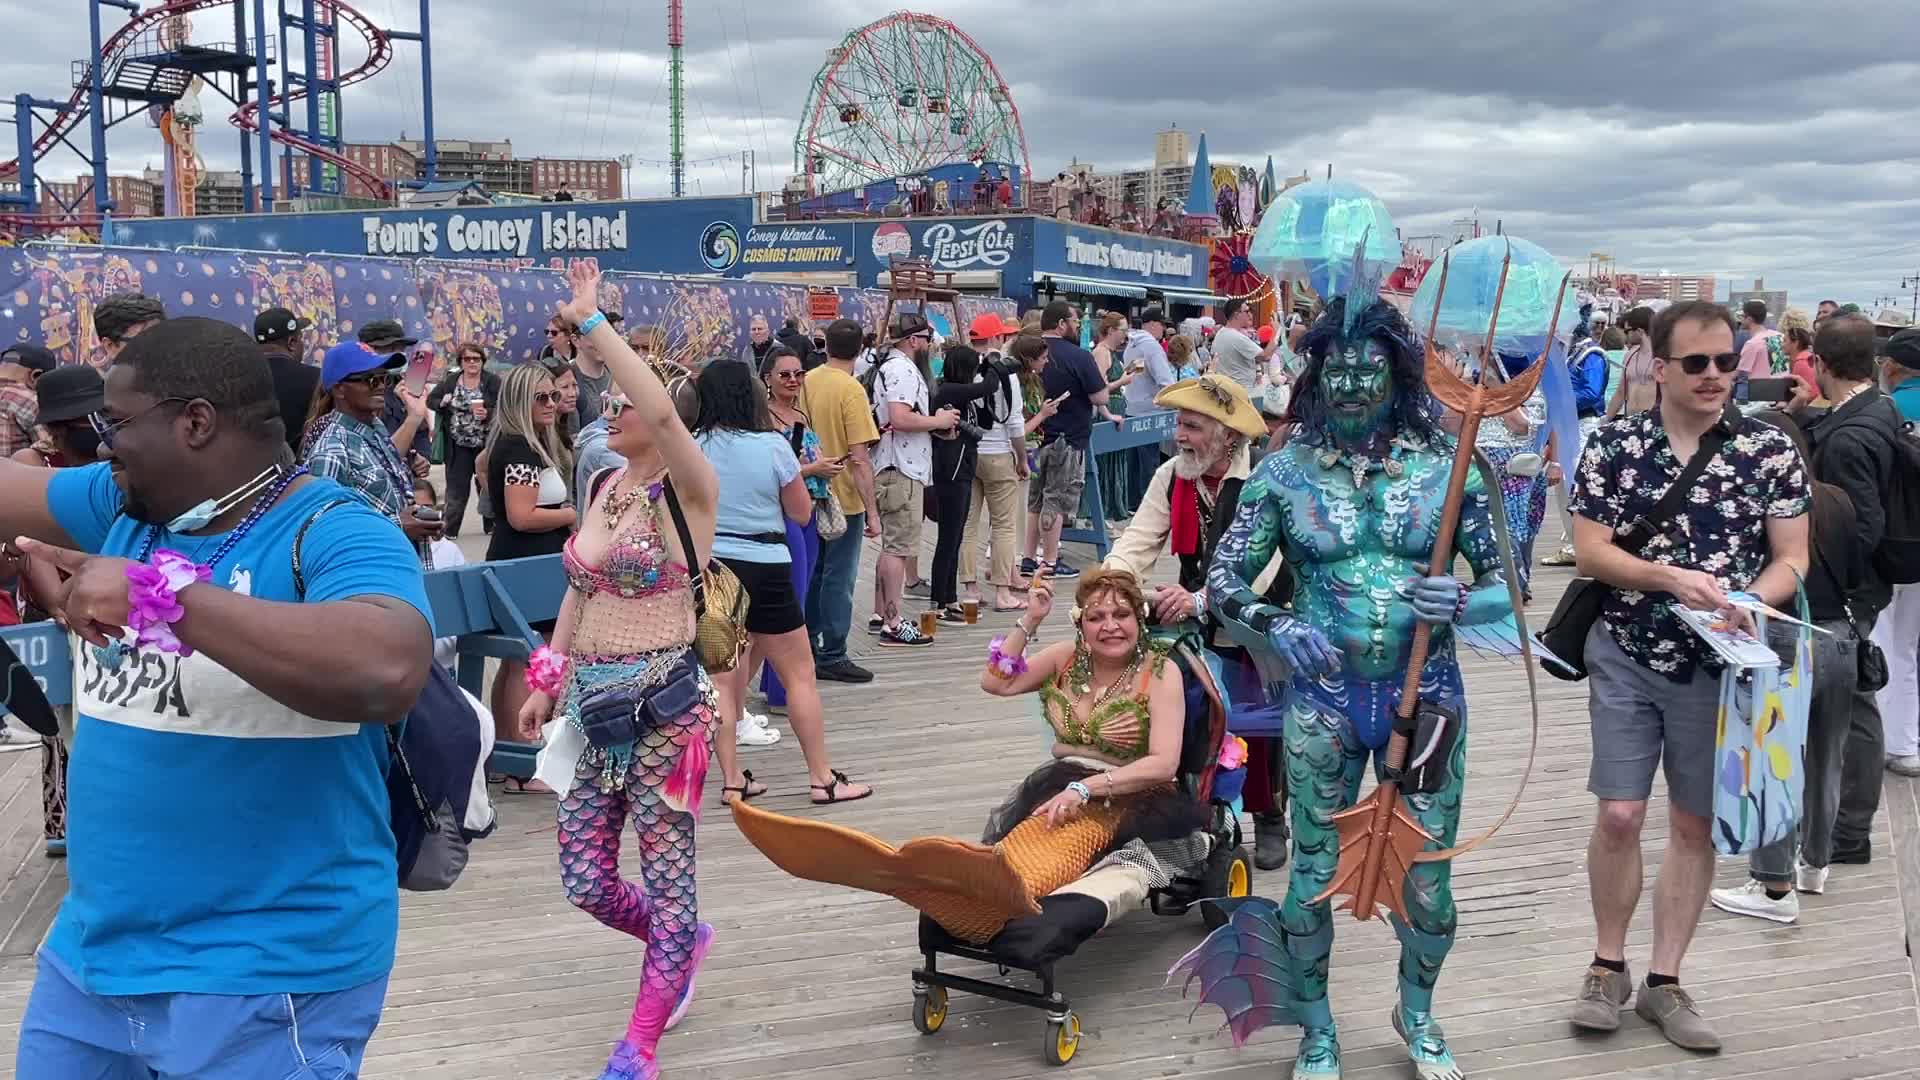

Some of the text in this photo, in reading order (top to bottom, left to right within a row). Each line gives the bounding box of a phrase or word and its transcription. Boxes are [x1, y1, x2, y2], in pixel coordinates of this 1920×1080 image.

[363, 210, 627, 256] Tom's Coney Island
[746, 227, 779, 247] Coney
[779, 226, 815, 242] Island
[743, 246, 843, 263] COSMOS COUNTRY!
[1066, 235, 1192, 277] Tom's Coney Island
